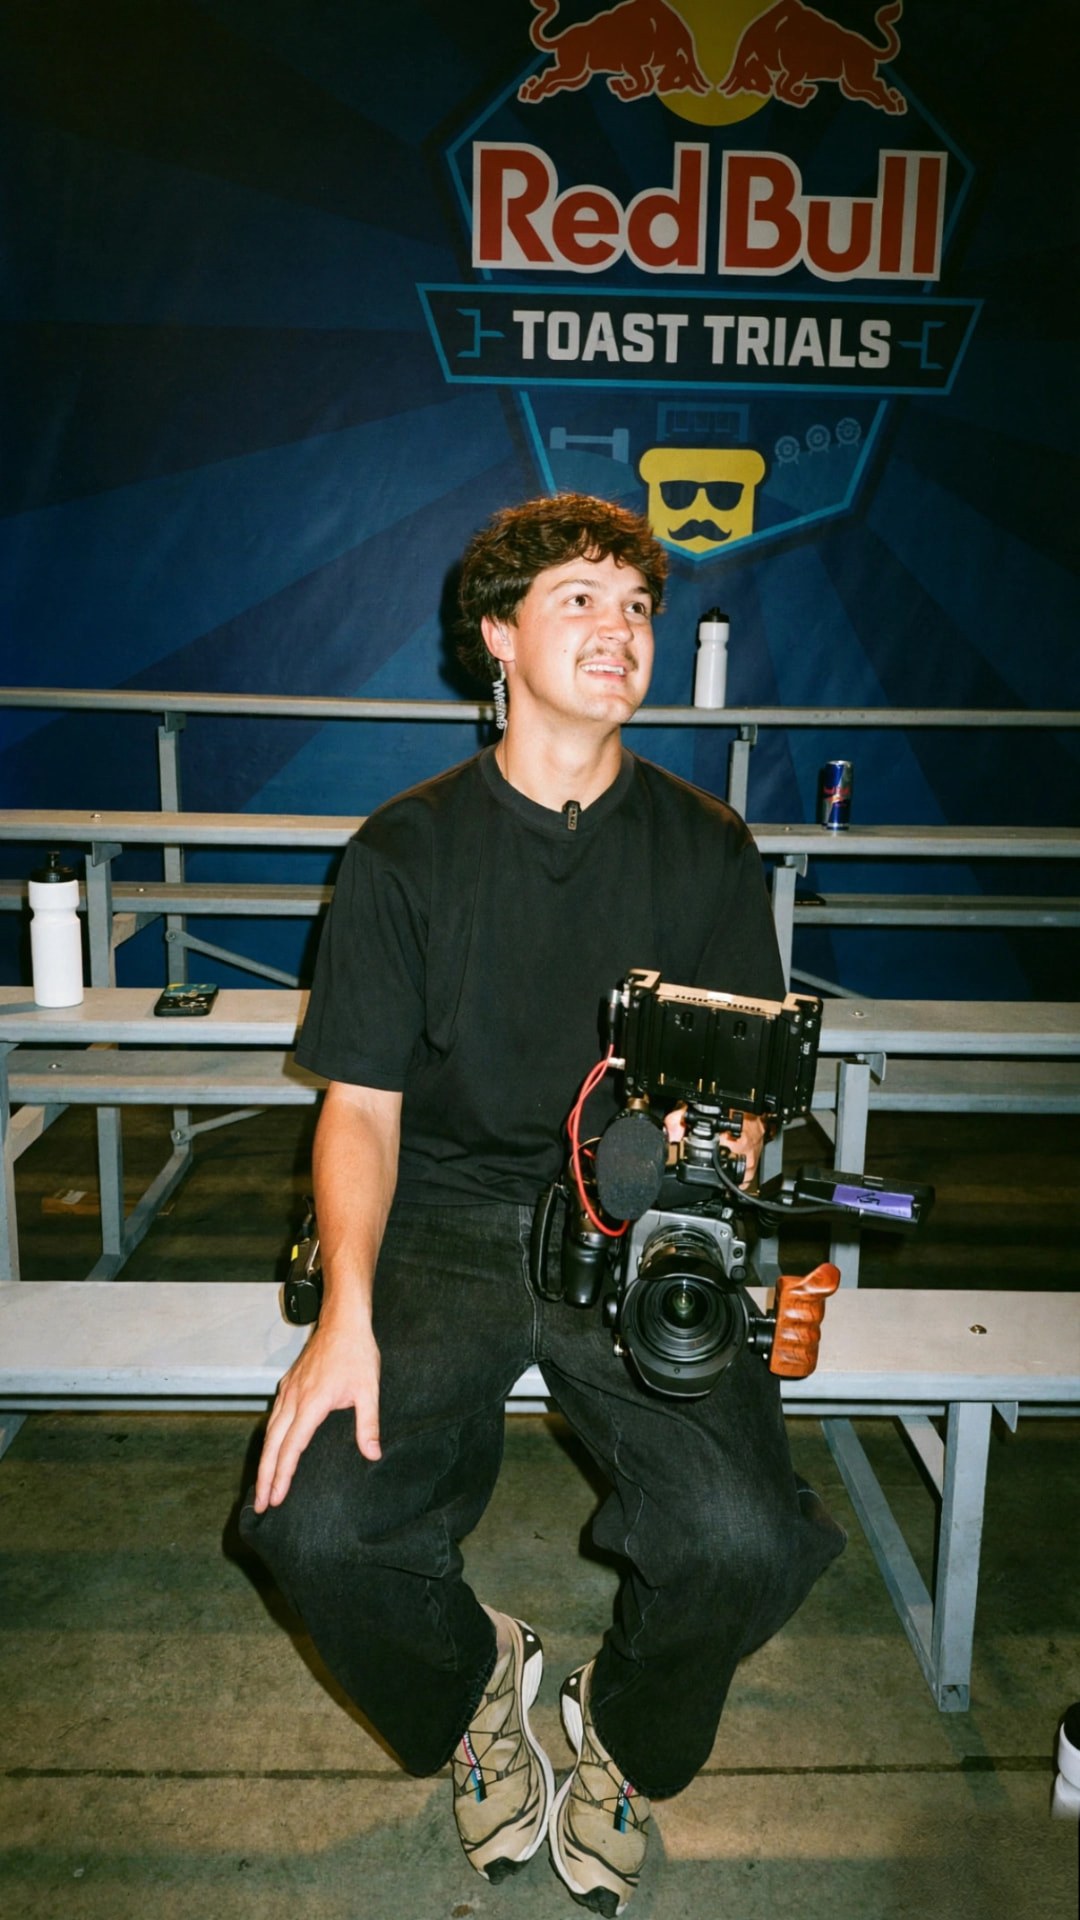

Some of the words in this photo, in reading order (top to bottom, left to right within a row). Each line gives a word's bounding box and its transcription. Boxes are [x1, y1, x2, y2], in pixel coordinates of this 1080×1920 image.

[476, 145, 706, 271] Red
[721, 152, 944, 278] Bull
[512, 310, 689, 365] TOAST
[703, 315, 891, 369] TRIALS
